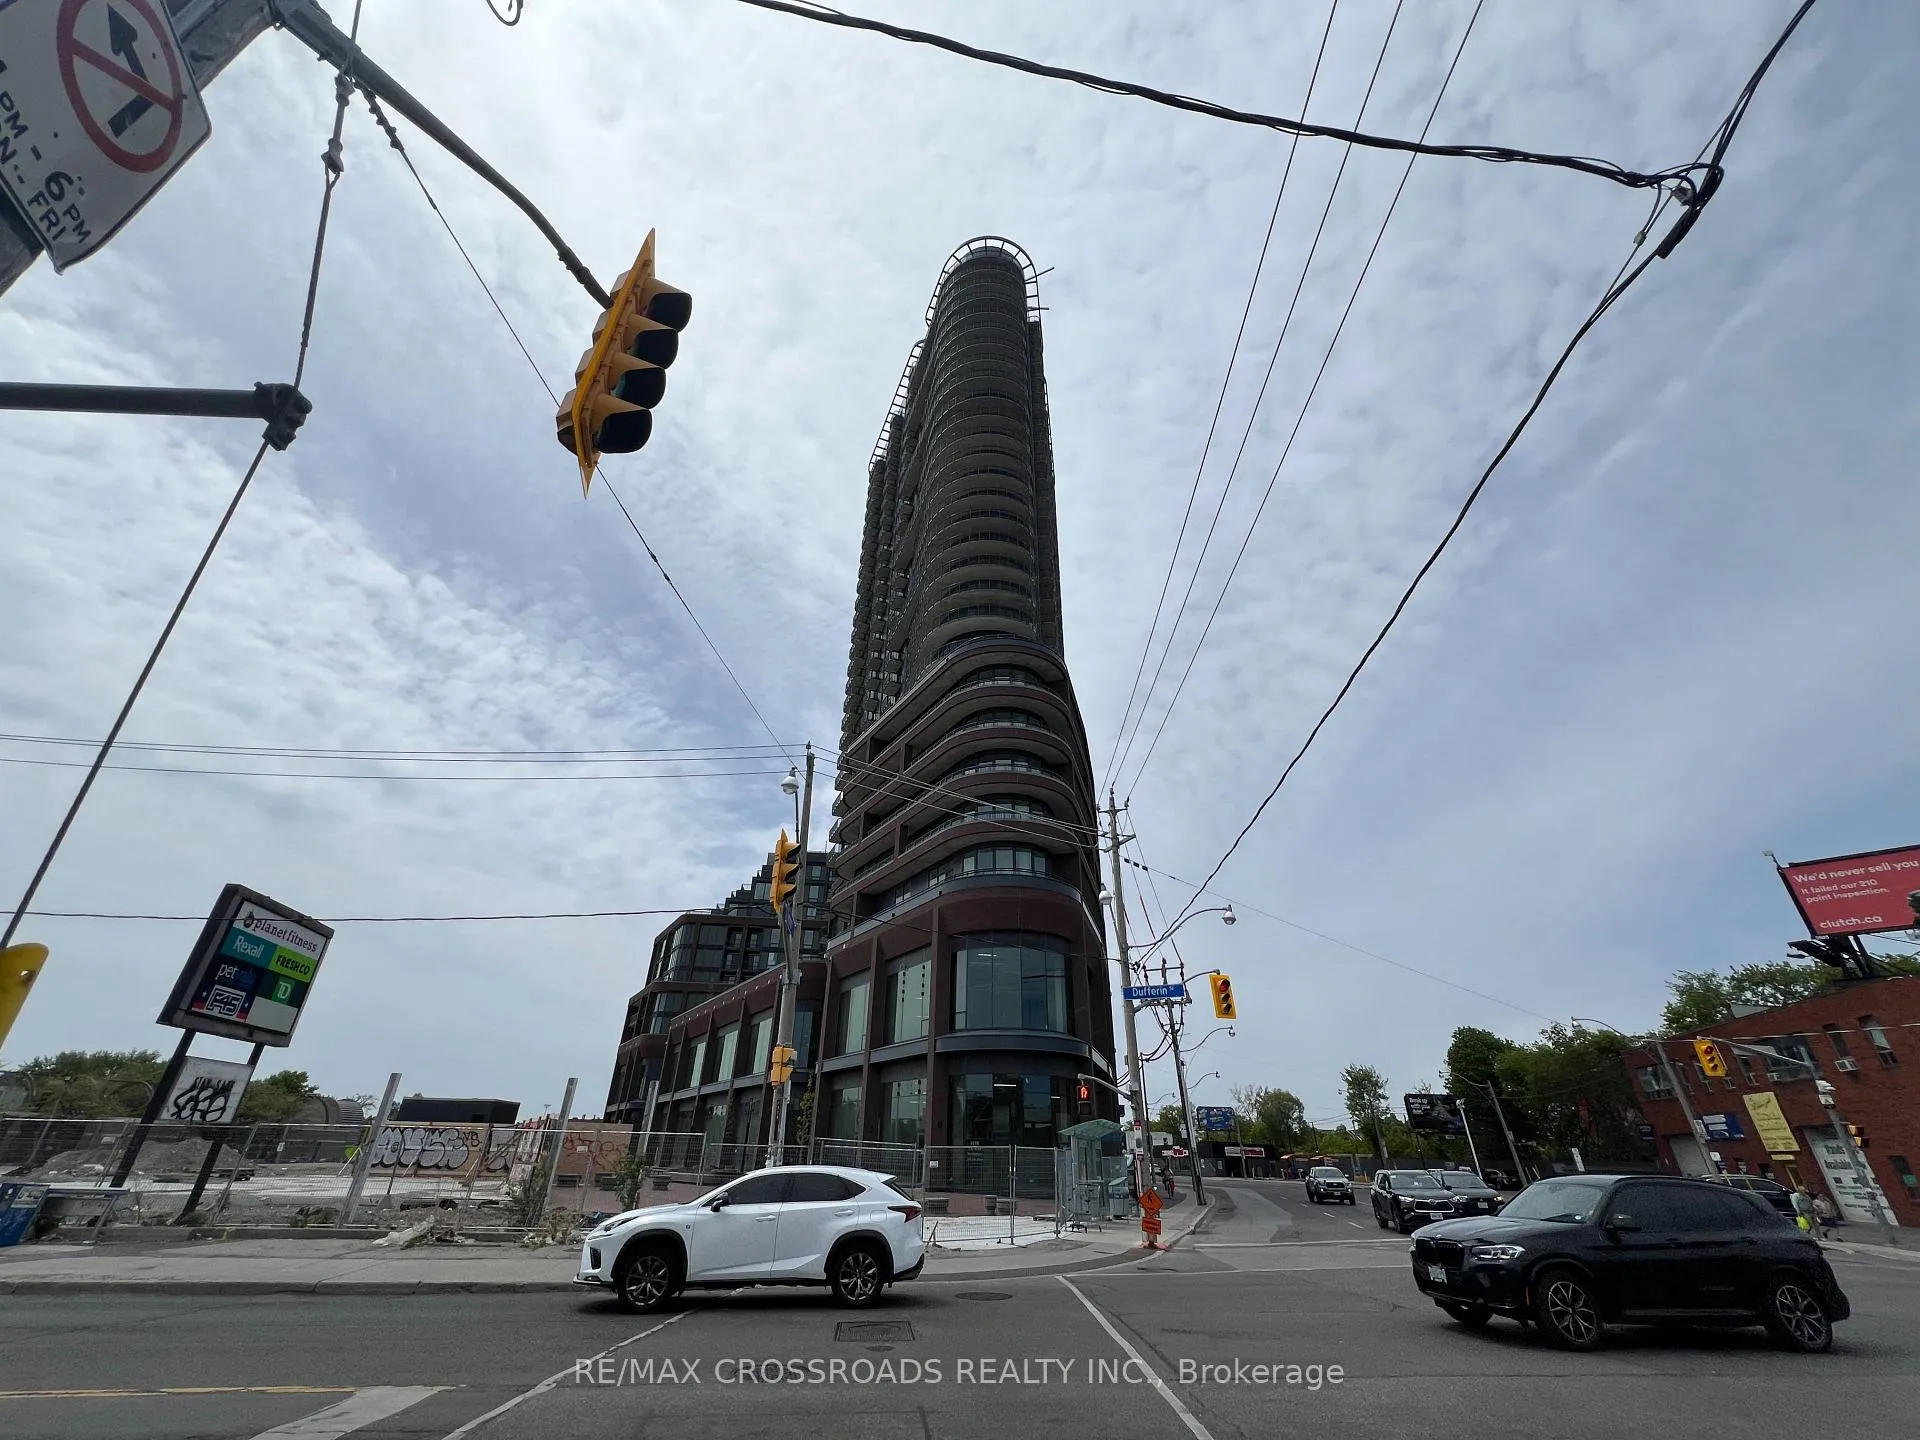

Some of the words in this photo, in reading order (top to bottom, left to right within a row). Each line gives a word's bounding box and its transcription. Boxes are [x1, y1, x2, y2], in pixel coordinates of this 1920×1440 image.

[27, 190, 67, 242] FRI
[1793, 872, 1827, 884] We'd
[1828, 868, 1865, 879] never
[1867, 862, 1891, 873] sell
[1893, 860, 1920, 872] you
[1801, 887, 1809, 895] It
[1810, 884, 1838, 894] failed
[1840, 881, 1857, 890] our
[1858, 879, 1878, 887] 210
[1805, 893, 1833, 904] point
[1820, 915, 1883, 928] clutch.ca
[232, 935, 265, 959] Rexall
[277, 981, 292, 999] TD
[1132, 986, 1168, 997] Dufferin
